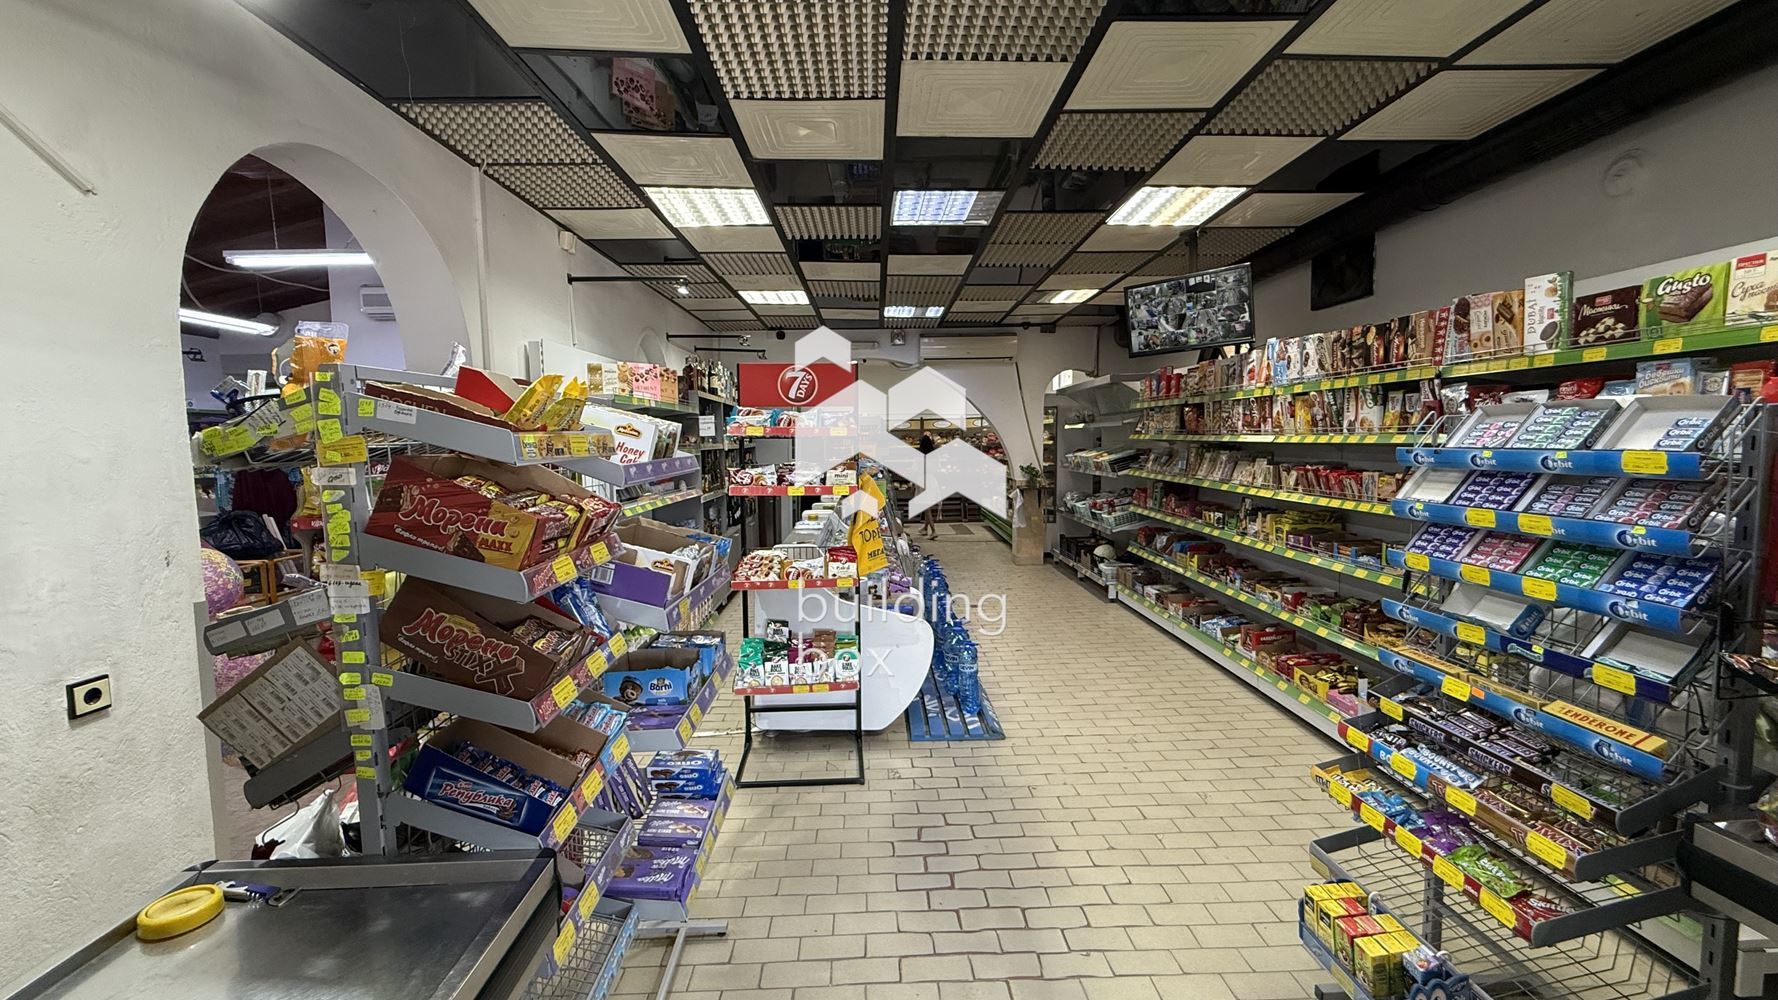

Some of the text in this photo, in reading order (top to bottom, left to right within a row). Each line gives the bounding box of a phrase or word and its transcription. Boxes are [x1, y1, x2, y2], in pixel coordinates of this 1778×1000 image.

[1657, 272, 1711, 296] Gusto
[1527, 299, 1537, 335] DUBAI
[786, 370, 813, 399] 7 DAYS
[1586, 427, 1605, 447] Orbit
[1668, 429, 1693, 437] Orbit
[1697, 427, 1721, 449] Orbit
[616, 441, 645, 458] Honey
[1412, 452, 1435, 466] Orbit
[1470, 453, 1497, 468] Orbit
[1540, 454, 1573, 471] Orbit
[1625, 490, 1646, 498] Orbit
[1668, 493, 1693, 501] Orbit
[398, 495, 510, 535] Морени
[1608, 509, 1630, 517] Orbit
[1688, 504, 1710, 528] Orbit
[477, 537, 514, 554] MAXX
[1616, 529, 1657, 548] Orbit
[1623, 571, 1645, 579] Orbit
[1677, 569, 1701, 578] Orbit
[1615, 580, 1637, 588] Orbit
[1667, 579, 1691, 587] Orbit
[1645, 594, 1668, 602] Orbit
[1658, 589, 1682, 597] Orbit
[1608, 600, 1649, 621] Orbit
[402, 608, 519, 662] Морени
[649, 683, 672, 691] Barni
[1513, 707, 1544, 729] Orbit
[1409, 717, 1446, 742] SNICKERS
[1424, 748, 1458, 772] BOUNTY
[1468, 747, 1511, 775] SNICKERS
[1594, 740, 1633, 767] Orbit
[439, 782, 515, 808] Република
[1532, 822, 1580, 854] TWIX
[637, 872, 674, 884] Milka
